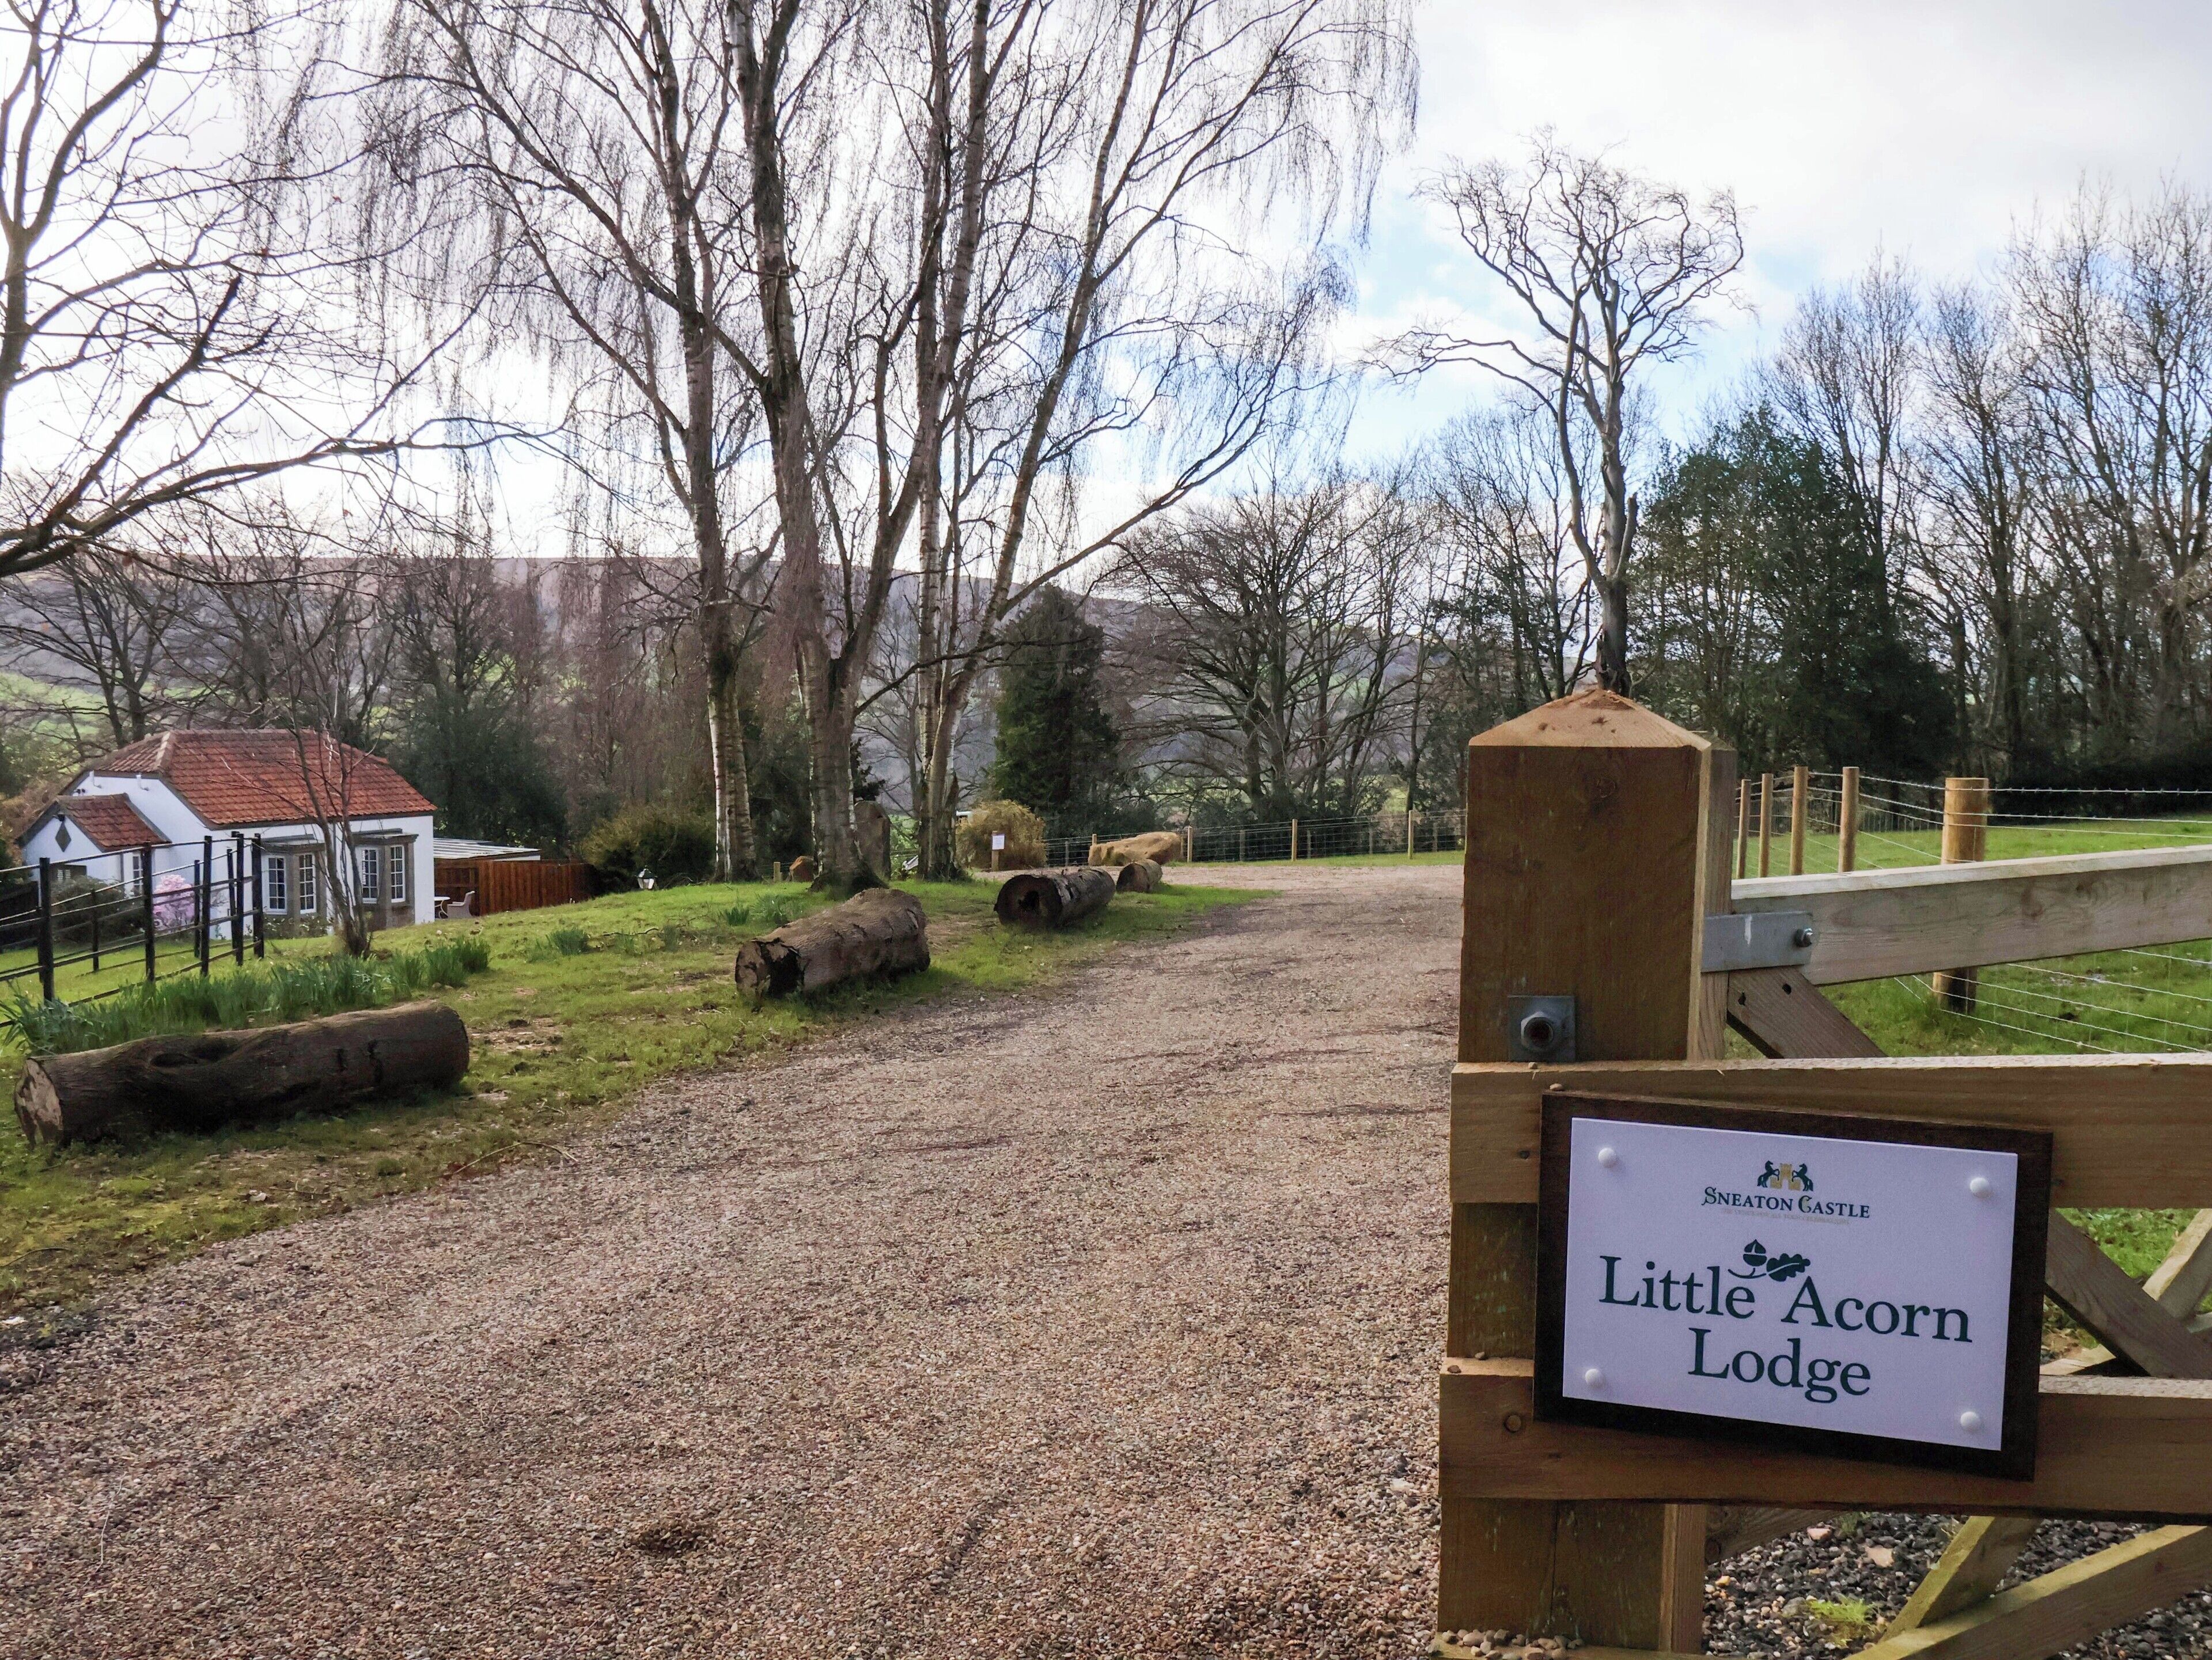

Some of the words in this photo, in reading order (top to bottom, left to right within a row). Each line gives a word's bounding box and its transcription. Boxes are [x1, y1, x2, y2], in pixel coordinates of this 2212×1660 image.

[1701, 1186, 1793, 1211] SNEATON
[1798, 1195, 1870, 1219] CASTLE
[1599, 1255, 1756, 1320] Little
[1780, 1275, 1974, 1344] Acorn
[1687, 1327, 1872, 1404] Lodge
